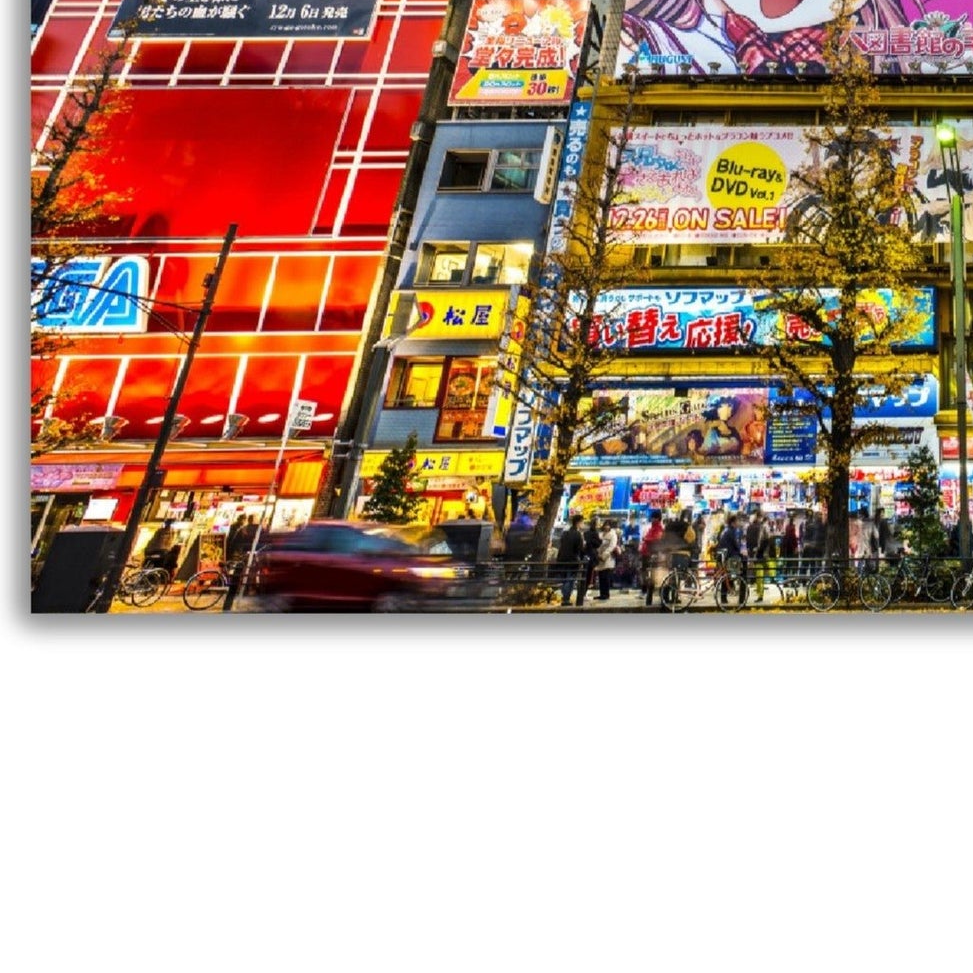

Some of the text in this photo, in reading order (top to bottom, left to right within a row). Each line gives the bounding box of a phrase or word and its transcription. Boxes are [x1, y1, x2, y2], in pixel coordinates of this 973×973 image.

[710, 177, 748, 196] DVD
[673, 207, 710, 231] ON
[665, 290, 747, 304] ソフマップ
[442, 304, 492, 326] 松屋
[421, 456, 452, 470] 松屋
